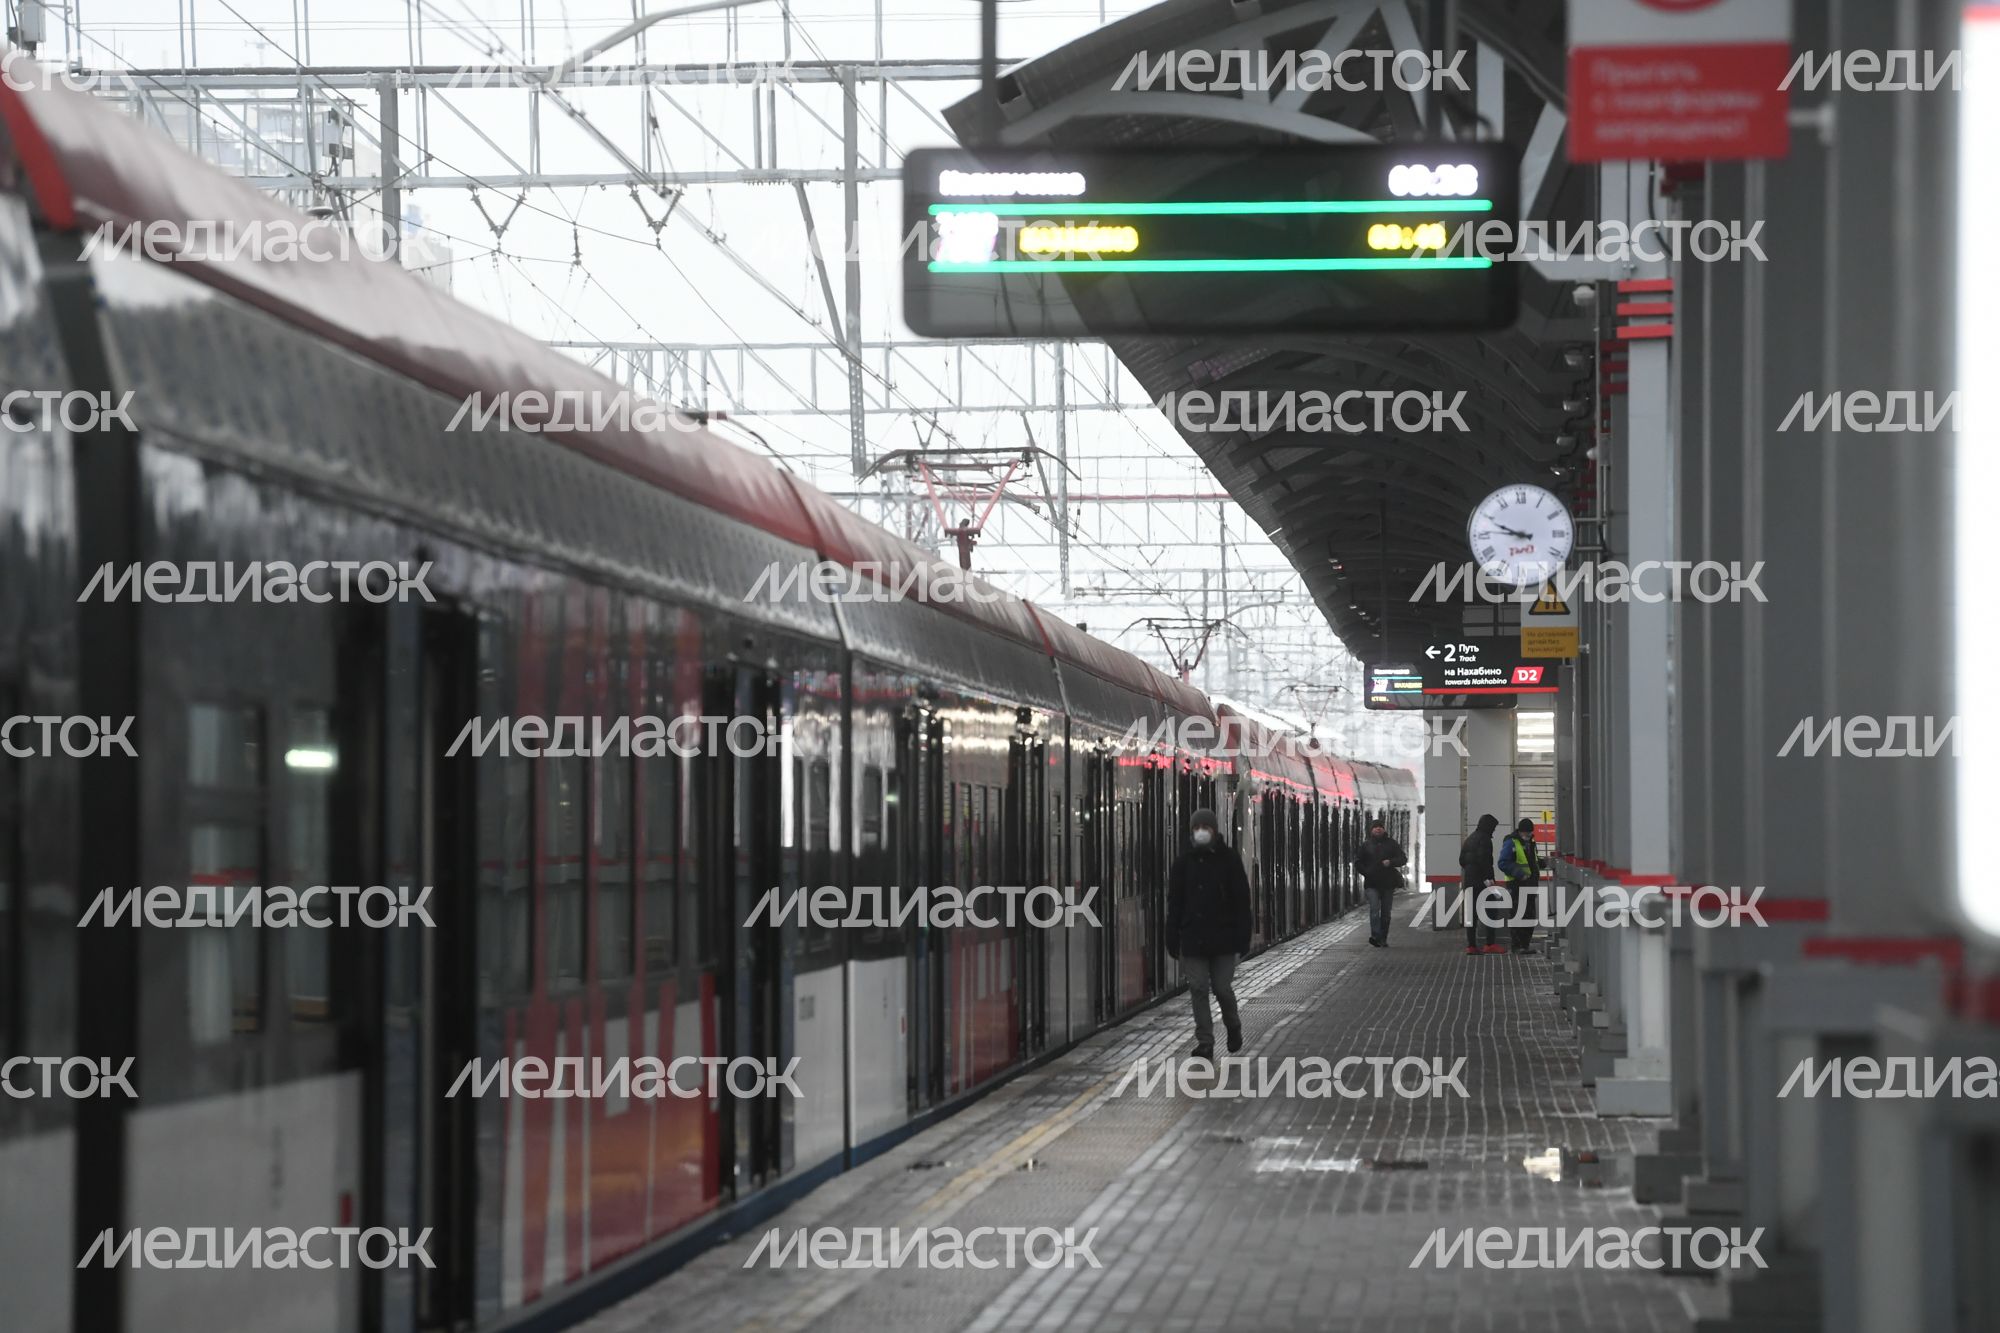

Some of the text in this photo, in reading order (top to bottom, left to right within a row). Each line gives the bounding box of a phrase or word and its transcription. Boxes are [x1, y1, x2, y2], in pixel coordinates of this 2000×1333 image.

[1443, 643, 1456, 662] 2
[1458, 643, 1480, 654] Путь
[1444, 666, 1502, 677] на Нахабино
[1517, 669, 1538, 681] D2
